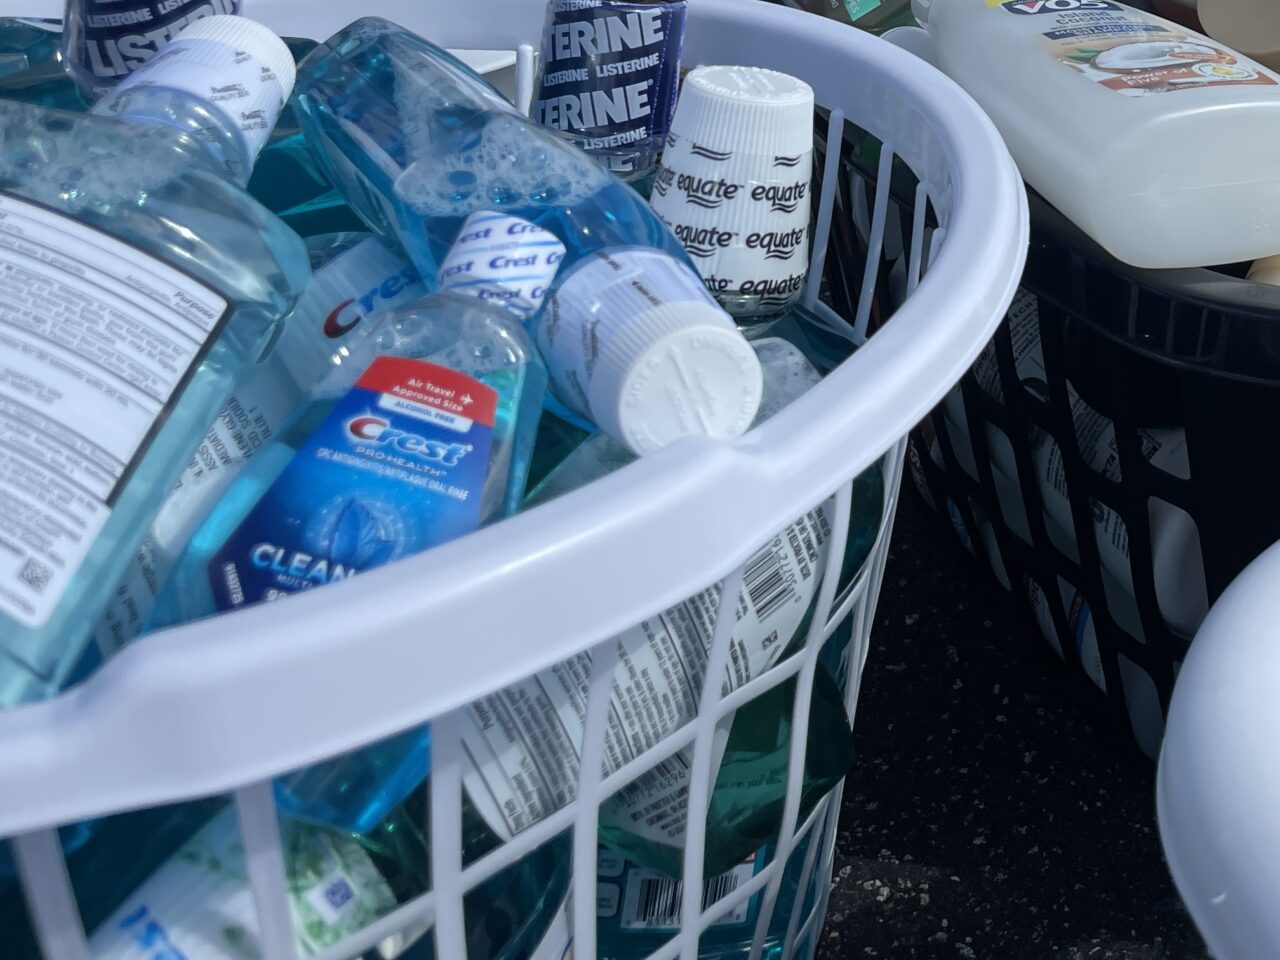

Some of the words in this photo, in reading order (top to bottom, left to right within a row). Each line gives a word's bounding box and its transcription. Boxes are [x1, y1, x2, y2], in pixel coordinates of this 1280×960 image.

[543, 68, 589, 87] LISTERINE
[596, 53, 660, 78] LISTERINE
[584, 126, 648, 150] LISTERINE
[677, 173, 739, 200] equate
[751, 182, 807, 207] equate
[746, 228, 803, 254] equate
[489, 255, 538, 269] Crest
[739, 274, 802, 300] equate
[174, 290, 216, 320] Purpose
[392, 385, 442, 405] Approved
[442, 398, 464, 412] Size
[408, 378, 424, 388] Air
[426, 381, 456, 398] Travel
[348, 416, 467, 466] Crest
